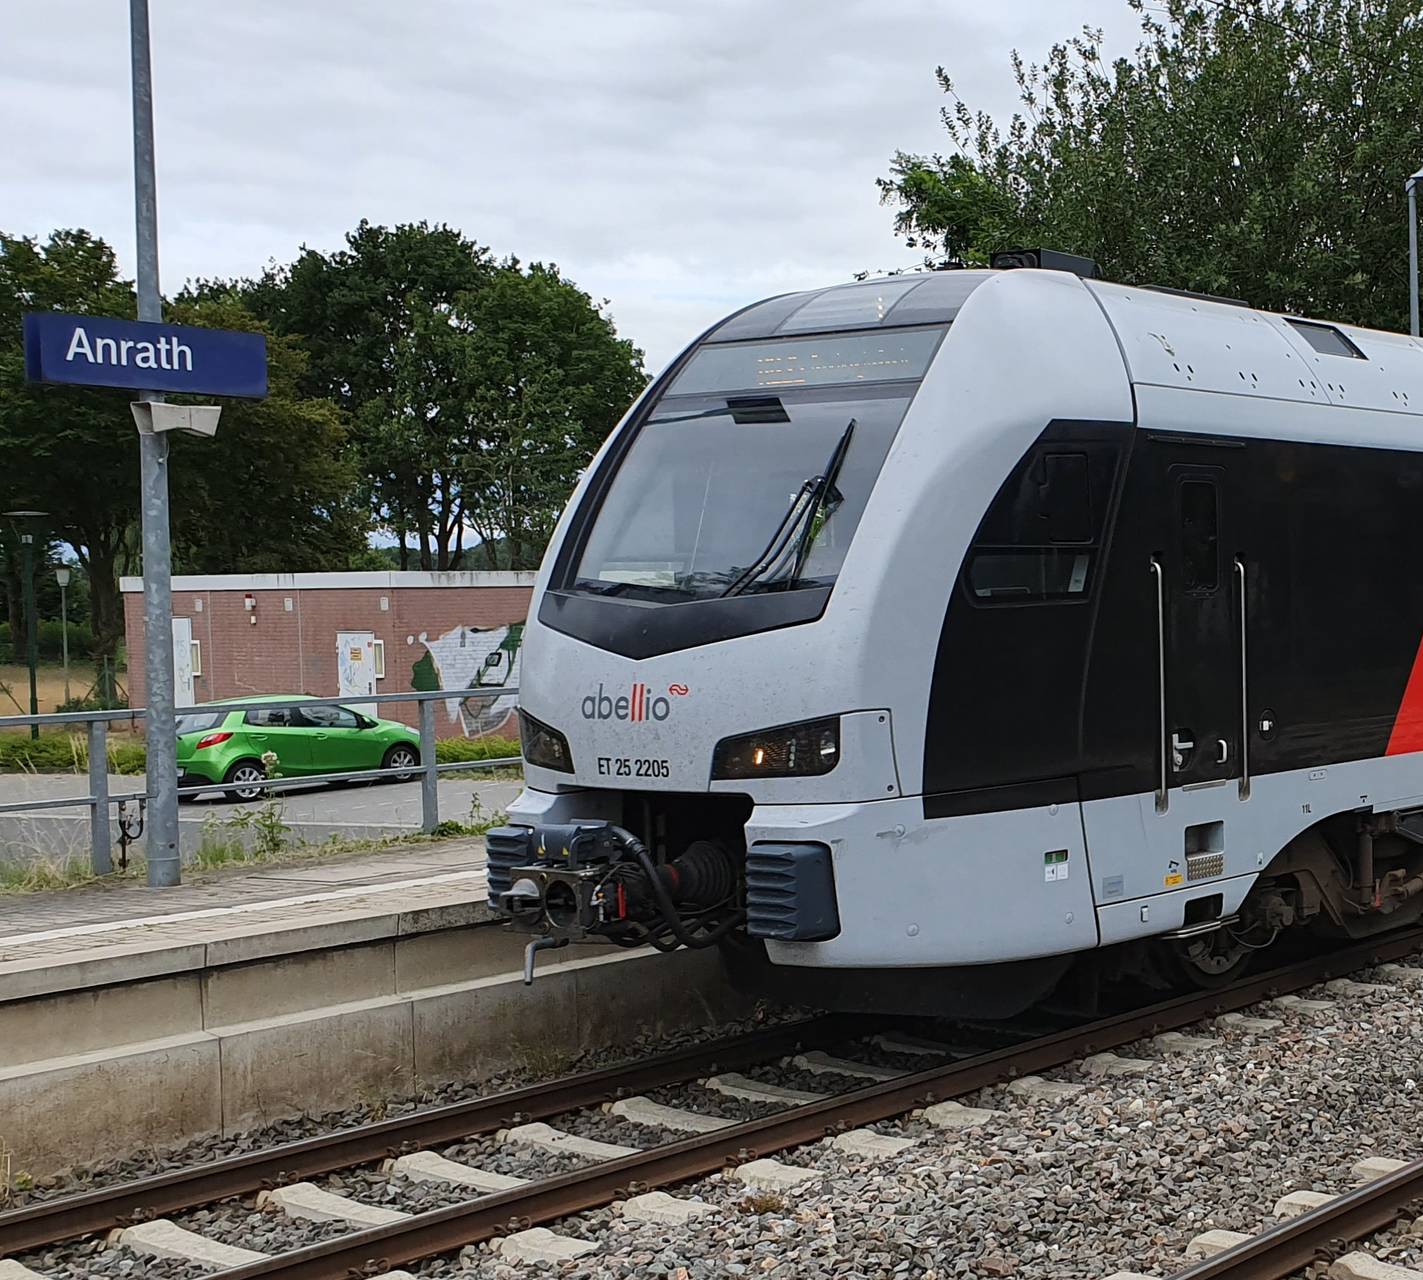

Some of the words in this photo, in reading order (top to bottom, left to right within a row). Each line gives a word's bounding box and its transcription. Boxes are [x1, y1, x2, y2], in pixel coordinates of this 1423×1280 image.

[66, 327, 193, 371] Anrath
[581, 683, 670, 722] abellio
[597, 757, 612, 775] ET
[615, 759, 631, 776] 25
[635, 759, 670, 778] 2205
